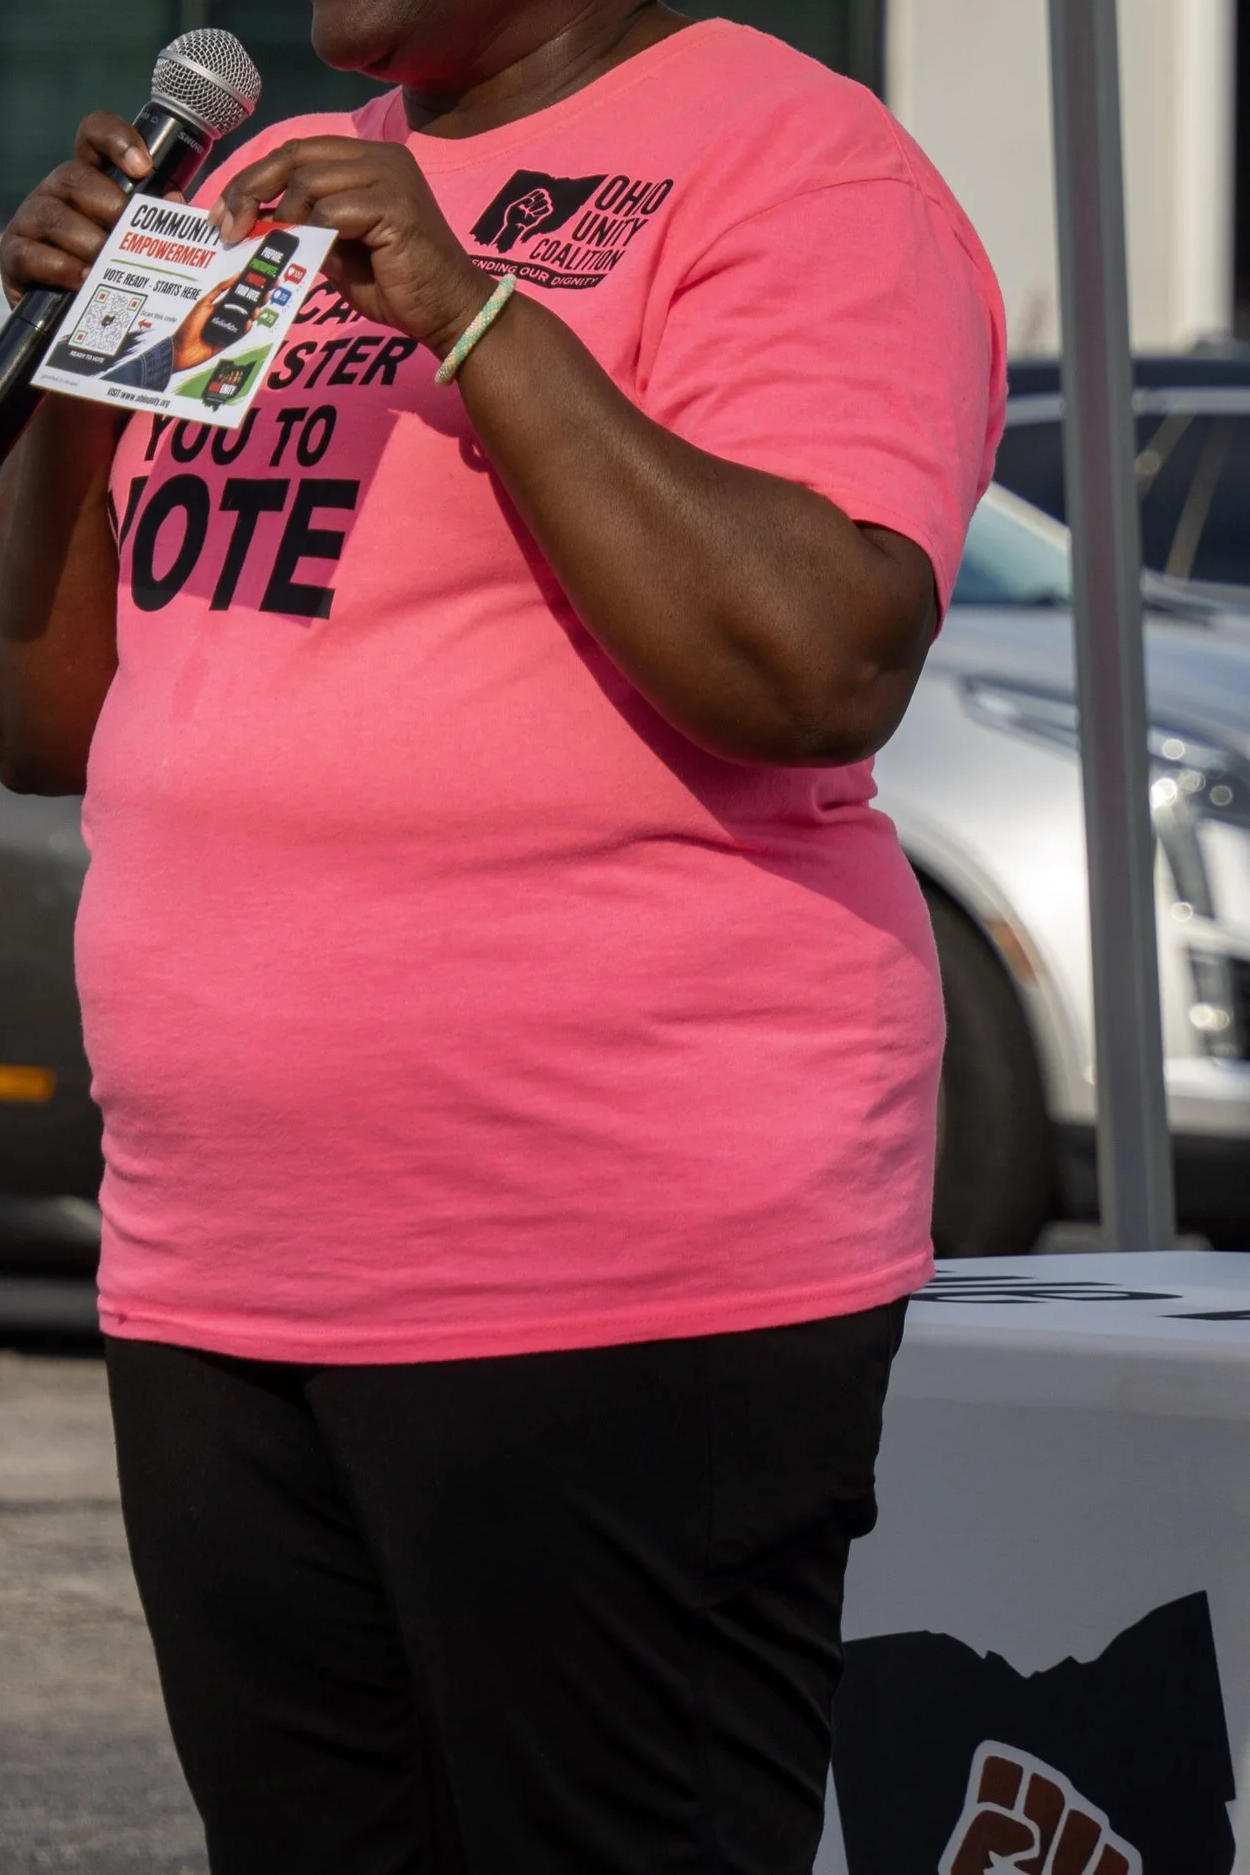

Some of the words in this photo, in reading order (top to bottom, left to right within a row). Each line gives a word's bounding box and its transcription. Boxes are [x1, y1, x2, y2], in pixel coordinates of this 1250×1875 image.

[595, 175, 674, 216] OHIO
[571, 211, 648, 247] UNITY
[118, 231, 217, 269] EMPOWERMENT
[529, 238, 625, 271] COALITION
[103, 267, 124, 284] VOTE
[123, 273, 150, 289] READY
[153, 280, 181, 297] STARTS
[180, 286, 202, 301] HERE
[470, 258, 518, 274] ENDING
[519, 266, 550, 281] OUR
[550, 276, 600, 286] DIGNITY
[291, 280, 363, 325] CA
[144, 407, 260, 466] YOU
[269, 404, 337, 467] TO
[108, 474, 361, 620] VOTE
